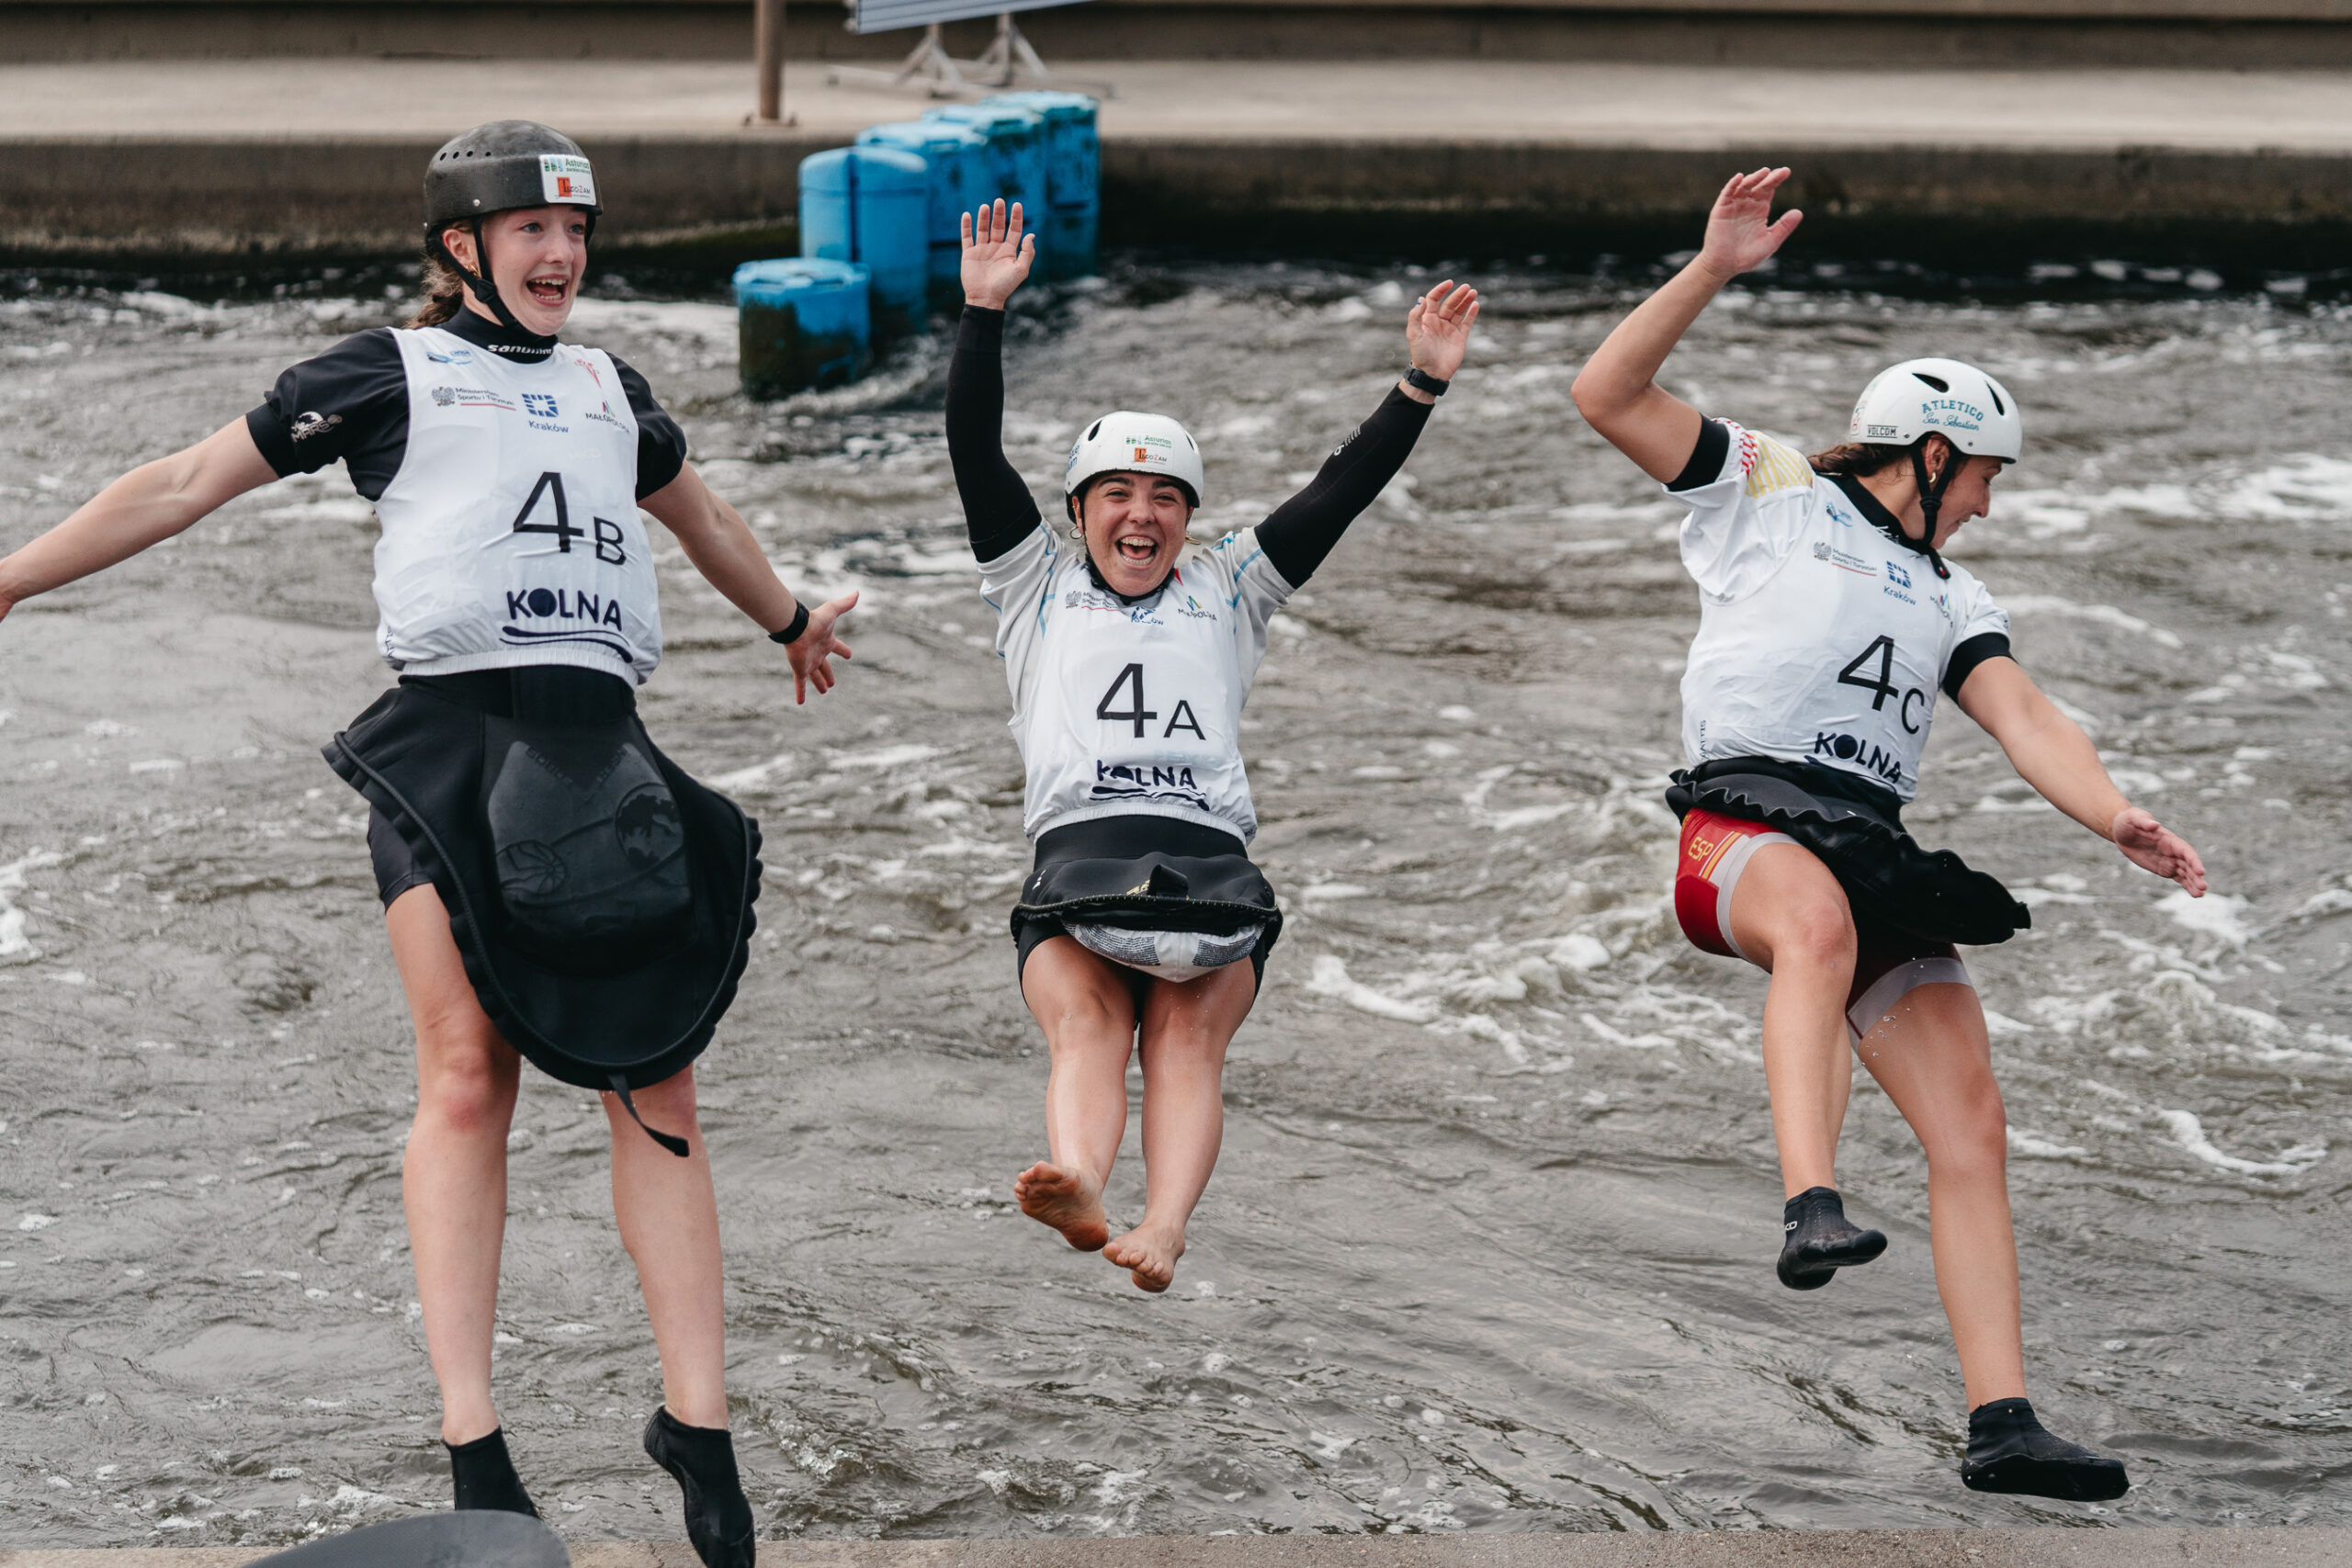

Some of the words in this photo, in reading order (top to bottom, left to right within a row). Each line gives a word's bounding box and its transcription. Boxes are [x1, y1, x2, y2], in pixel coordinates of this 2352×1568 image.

[1922, 399, 1984, 422] ATLETICO
[529, 420, 569, 433] Kraków
[1867, 427, 1897, 436] VOLCOM
[1922, 412, 1940, 425] San
[1942, 413, 1981, 432] Sebastian
[1883, 585, 1916, 605] Kraków
[506, 587, 623, 632] KOLNA
[1814, 731, 1903, 784] KOLNA
[1687, 836, 1715, 862] ESP
